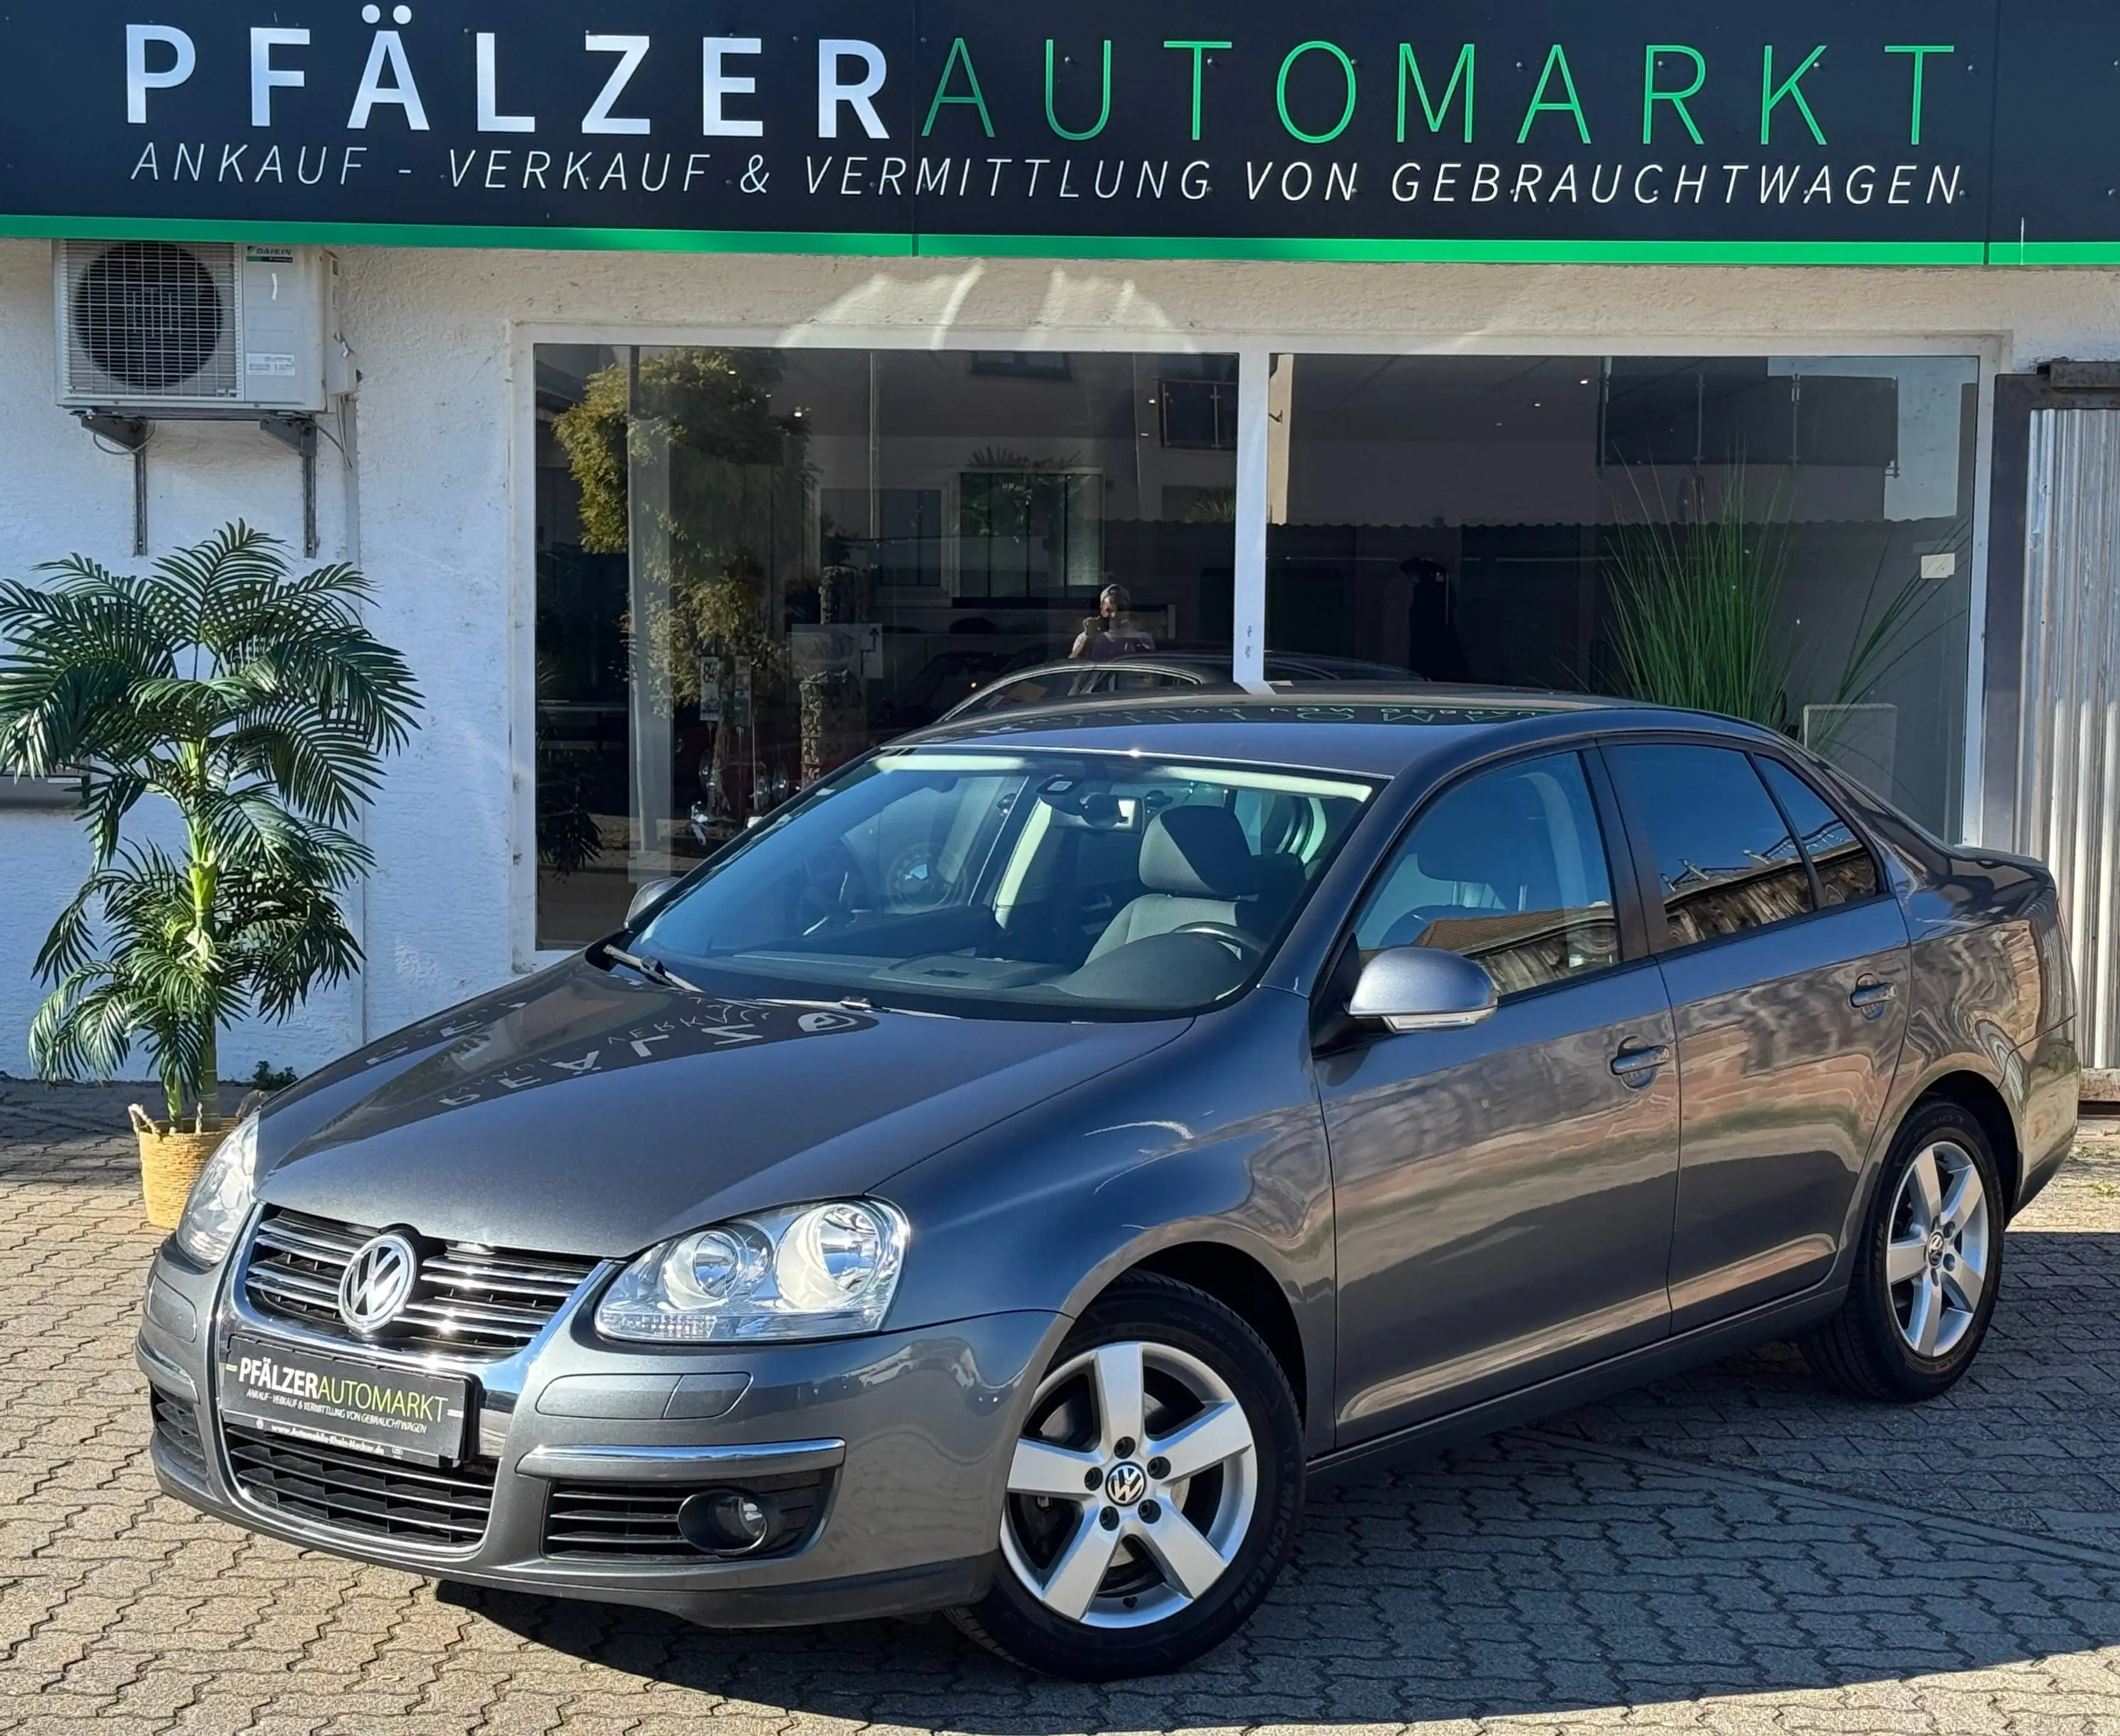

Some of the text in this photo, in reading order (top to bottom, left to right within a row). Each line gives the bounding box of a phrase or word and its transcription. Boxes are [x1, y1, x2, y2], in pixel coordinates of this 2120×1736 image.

[130, 142, 368, 185] ANKAUF
[450, 149, 711, 192] VERKAUF
[740, 154, 770, 193] &
[807, 156, 1210, 200] VERMITTLUNG
[1247, 161, 1357, 201] VON
[1392, 162, 1961, 204] GEBRAUCHTWAGEN
